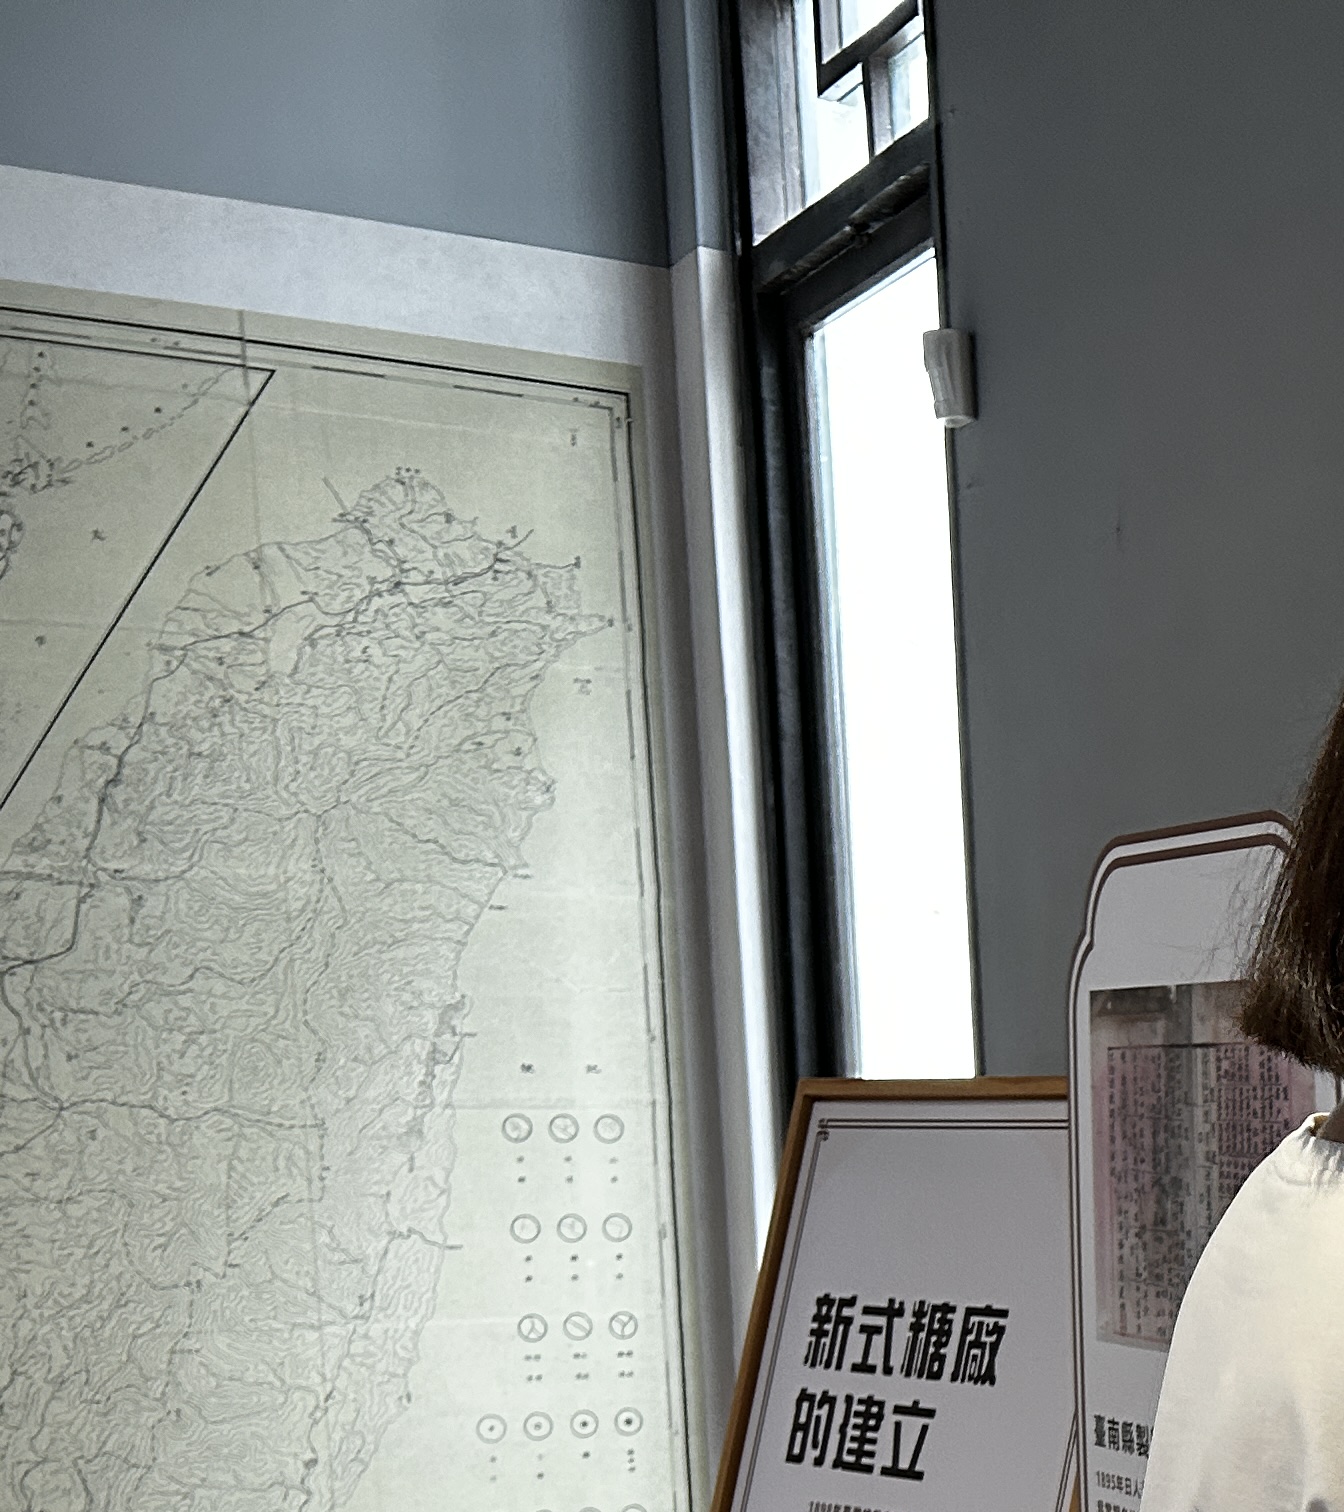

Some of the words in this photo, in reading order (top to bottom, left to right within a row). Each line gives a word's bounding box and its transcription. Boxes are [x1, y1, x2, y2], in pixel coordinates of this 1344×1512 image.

[804, 1293, 1009, 1386] 新式糖廠
[786, 1388, 936, 1481] 的建立
[1094, 1414, 1154, 1459] 臺南縣製
